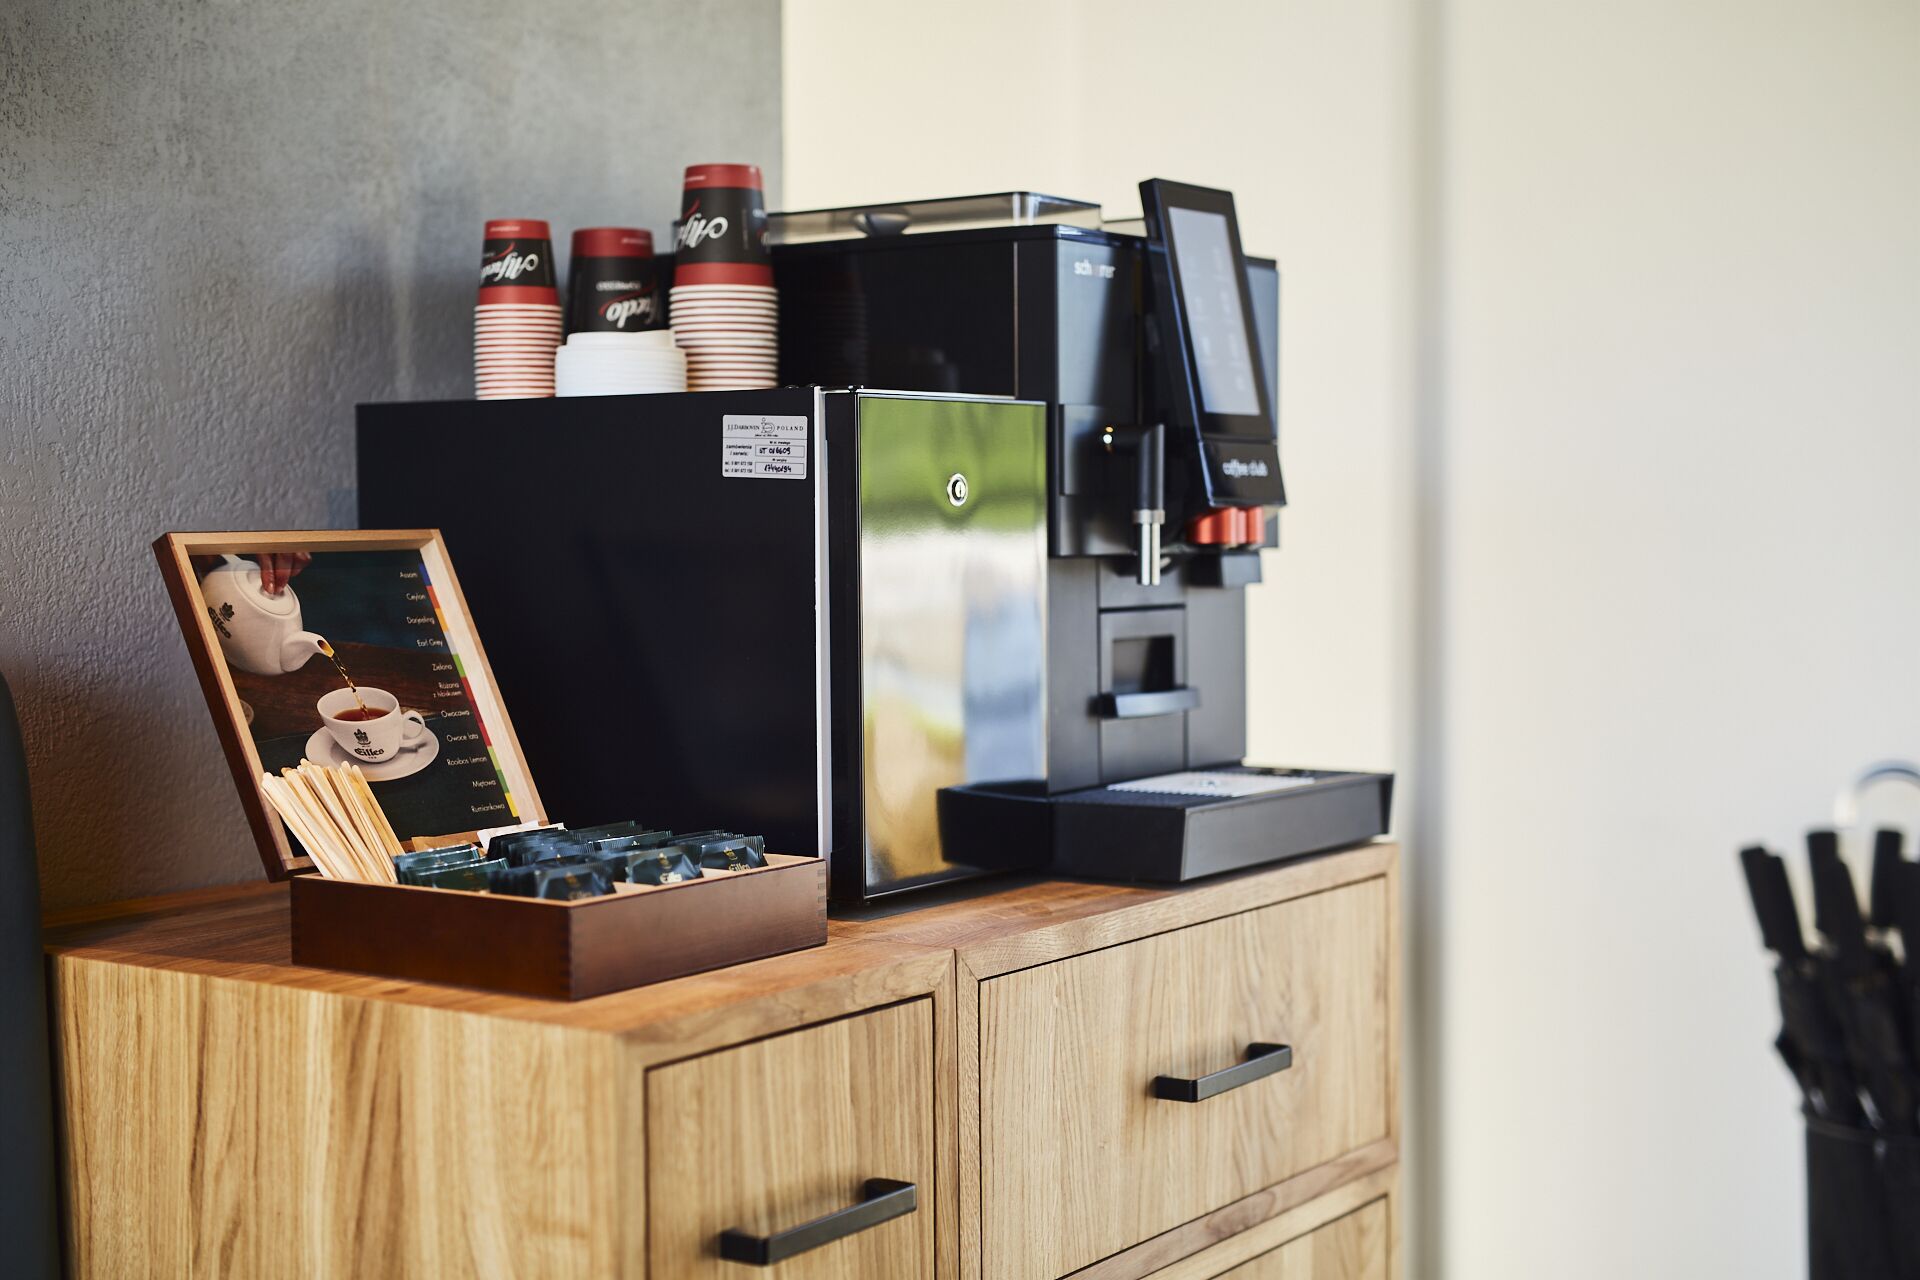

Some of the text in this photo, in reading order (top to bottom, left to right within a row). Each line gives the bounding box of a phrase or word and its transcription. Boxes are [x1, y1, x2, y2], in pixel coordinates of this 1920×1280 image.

[1073, 258, 1116, 279] schrer
[406, 592, 426, 601] Ceylon
[406, 616, 435, 625] Darjeeling
[416, 639, 443, 647] Earl Grey
[432, 663, 453, 671] Zielona
[440, 710, 470, 718] Owocowa
[446, 732, 479, 742] Owoce lata
[446, 756, 487, 766] Rooibos Lemon
[472, 779, 497, 788] Miętowa
[470, 803, 505, 813] Rumiankowa
